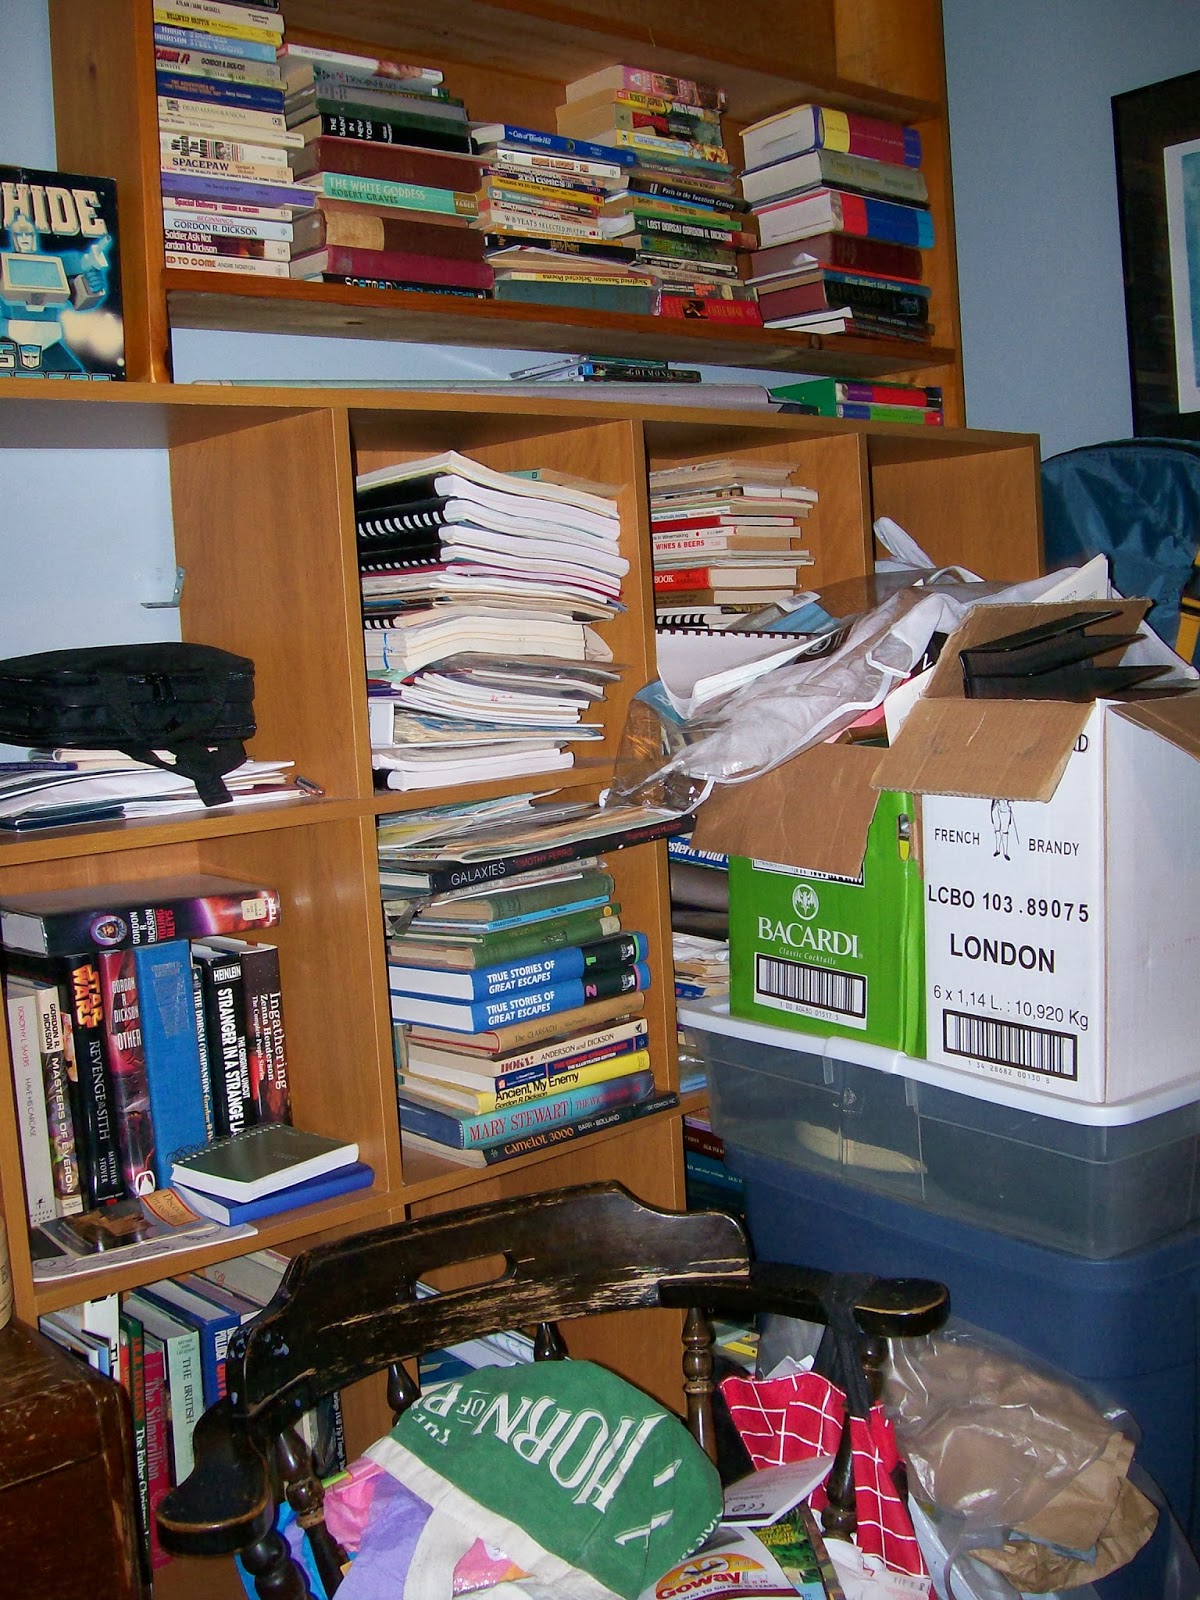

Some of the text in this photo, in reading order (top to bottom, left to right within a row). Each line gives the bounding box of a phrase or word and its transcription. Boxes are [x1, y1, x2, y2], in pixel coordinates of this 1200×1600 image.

[203, 5, 220, 13] GASKELL
[161, 26, 187, 36] HARRY
[190, 39, 212, 49] STEEL
[201, 57, 221, 67] GORDON
[349, 122, 355, 132] IN
[365, 120, 373, 140] YORK
[171, 139, 180, 150] We
[180, 135, 190, 156] Reach
[190, 141, 199, 153] The
[200, 139, 208, 158] Moon
[172, 157, 229, 171] SPACEPAW
[328, 177, 426, 201] THE WHITE GODDESS
[535, 178, 566, 187] COMICS
[174, 198, 218, 211] Special Delivery
[331, 189, 399, 205] ROBERT GRAVES
[455, 200, 475, 209] FABER
[662, 187, 675, 196] Paris
[682, 191, 691, 200] the
[692, 194, 715, 205] Twentieth
[715, 199, 735, 210] Century
[173, 220, 258, 236] GORDON R. DICKSON
[197, 215, 234, 225] BEGINNINGS
[538, 221, 566, 232] SELECTED
[646, 219, 733, 243] LOST DORSAI GORDON DICKSON
[187, 233, 212, 243] Ask Not
[192, 244, 218, 254] Dickson
[178, 255, 256, 271] TO COME ANDRE NORTON
[543, 274, 648, 286] Siegfried Sassoon Selected Poems
[655, 542, 676, 551] WINES
[683, 539, 705, 548] BEERS
[654, 574, 674, 584] BOOK
[451, 862, 506, 887] GALAXIES
[514, 854, 546, 869] TIMOTHY
[547, 846, 574, 860] FERRIS
[660, 822, 683, 833] Hudson
[934, 828, 1080, 857] FRENCH BRANDY
[928, 884, 975, 910] LCBO
[130, 911, 141, 945] GORDON
[145, 908, 155, 944] DICKSON
[156, 908, 165, 940] YOUNG
[165, 909, 176, 937] BLEYS
[758, 916, 859, 959] BACARDI
[586, 956, 597, 966] 1
[779, 946, 837, 966] Classic Cocktails
[950, 933, 1055, 974] LONDON
[213, 964, 242, 983] HEINLEIN
[486, 959, 556, 984] TRUE STORIES OF
[488, 972, 551, 995] GREAT ESCAPES
[72, 964, 92, 1028] WARS
[87, 965, 105, 1029] STAR
[111, 977, 136, 995] GORDON
[586, 984, 598, 998] 2
[113, 1005, 140, 1023] DICKSON
[486, 991, 555, 1015] TRUE STORIES OF
[488, 1003, 551, 1027] GREAT ESCAPES
[815, 1007, 832, 1019] 01517
[934, 984, 1089, 1031] 6 x 1,14 10,920 Kg
[18, 1005, 30, 1068] DOROTHY SAYERS
[42, 1013, 53, 1051] DICKSON
[48, 1003, 60, 1050] GORDON R.
[194, 1010, 206, 1041] DORSAI
[260, 993, 275, 1081] Zenna Henderson
[117, 1031, 142, 1051] OTHER
[251, 995, 265, 1081] The Complete People Stories
[269, 991, 288, 1090] Ingathering
[514, 1035, 526, 1043] The
[217, 988, 243, 1121] STRANGER IN A STRANGE
[238, 1049, 249, 1078] ORIGINAL
[501, 1032, 615, 1074] HOKA! ANDERSON and DICKSON
[198, 1042, 208, 1093] COMPANION
[990, 1064, 1012, 1075] 28682
[1017, 1071, 1041, 1082] 00130
[88, 1040, 111, 1140] REVENGE SITH
[241, 1078, 251, 1099] UNCUT
[495, 1083, 532, 1103] Ancient,
[533, 1079, 547, 1092] My
[549, 1072, 579, 1088] Enemy
[25, 1077, 37, 1137] HAVE CARCASE
[203, 1094, 212, 1123] Gordon
[494, 1091, 548, 1110] Gordon Dickson
[51, 1057, 74, 1194] MASTERS OF EVERON
[469, 1099, 569, 1143] MARY STEWART
[504, 1113, 620, 1156] Camelot 3000 BARR BOLLAND
[98, 1157, 109, 1184] STOVER
[107, 1150, 118, 1186] MATTHEW
[213, 1330, 226, 1361] POLLOCK
[182, 1356, 196, 1425] THE BRITISH
[132, 1369, 147, 1480] TOLKIEN The Father
[144, 1380, 159, 1481] The Silmarillion
[411, 1413, 450, 1446] THE
[456, 1392, 668, 1513] HORN OF
[656, 1571, 741, 1600] Goway
